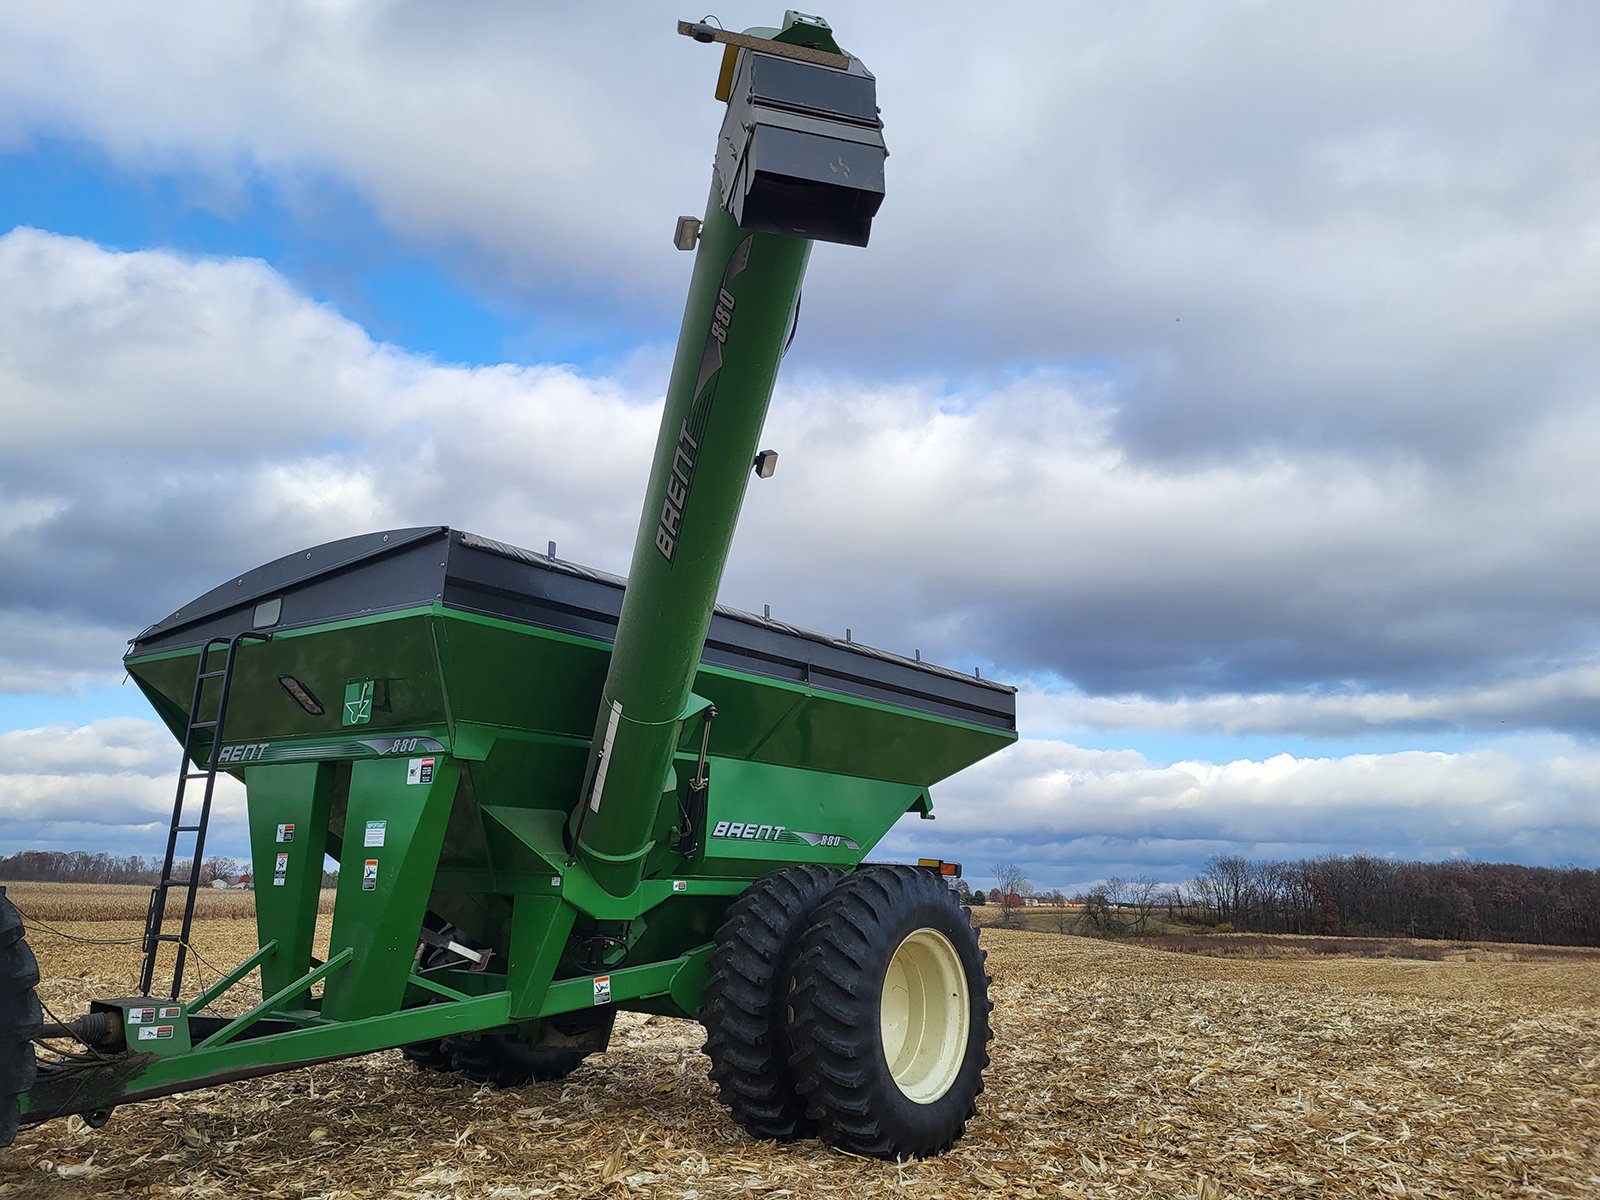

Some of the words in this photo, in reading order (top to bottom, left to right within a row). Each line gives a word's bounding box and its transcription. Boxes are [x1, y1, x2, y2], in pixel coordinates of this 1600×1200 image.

[655, 418, 698, 560] BRENT
[711, 287, 735, 343] 880
[392, 738, 417, 753] 880
[712, 821, 786, 840] BRENT
[820, 835, 841, 847] 880
